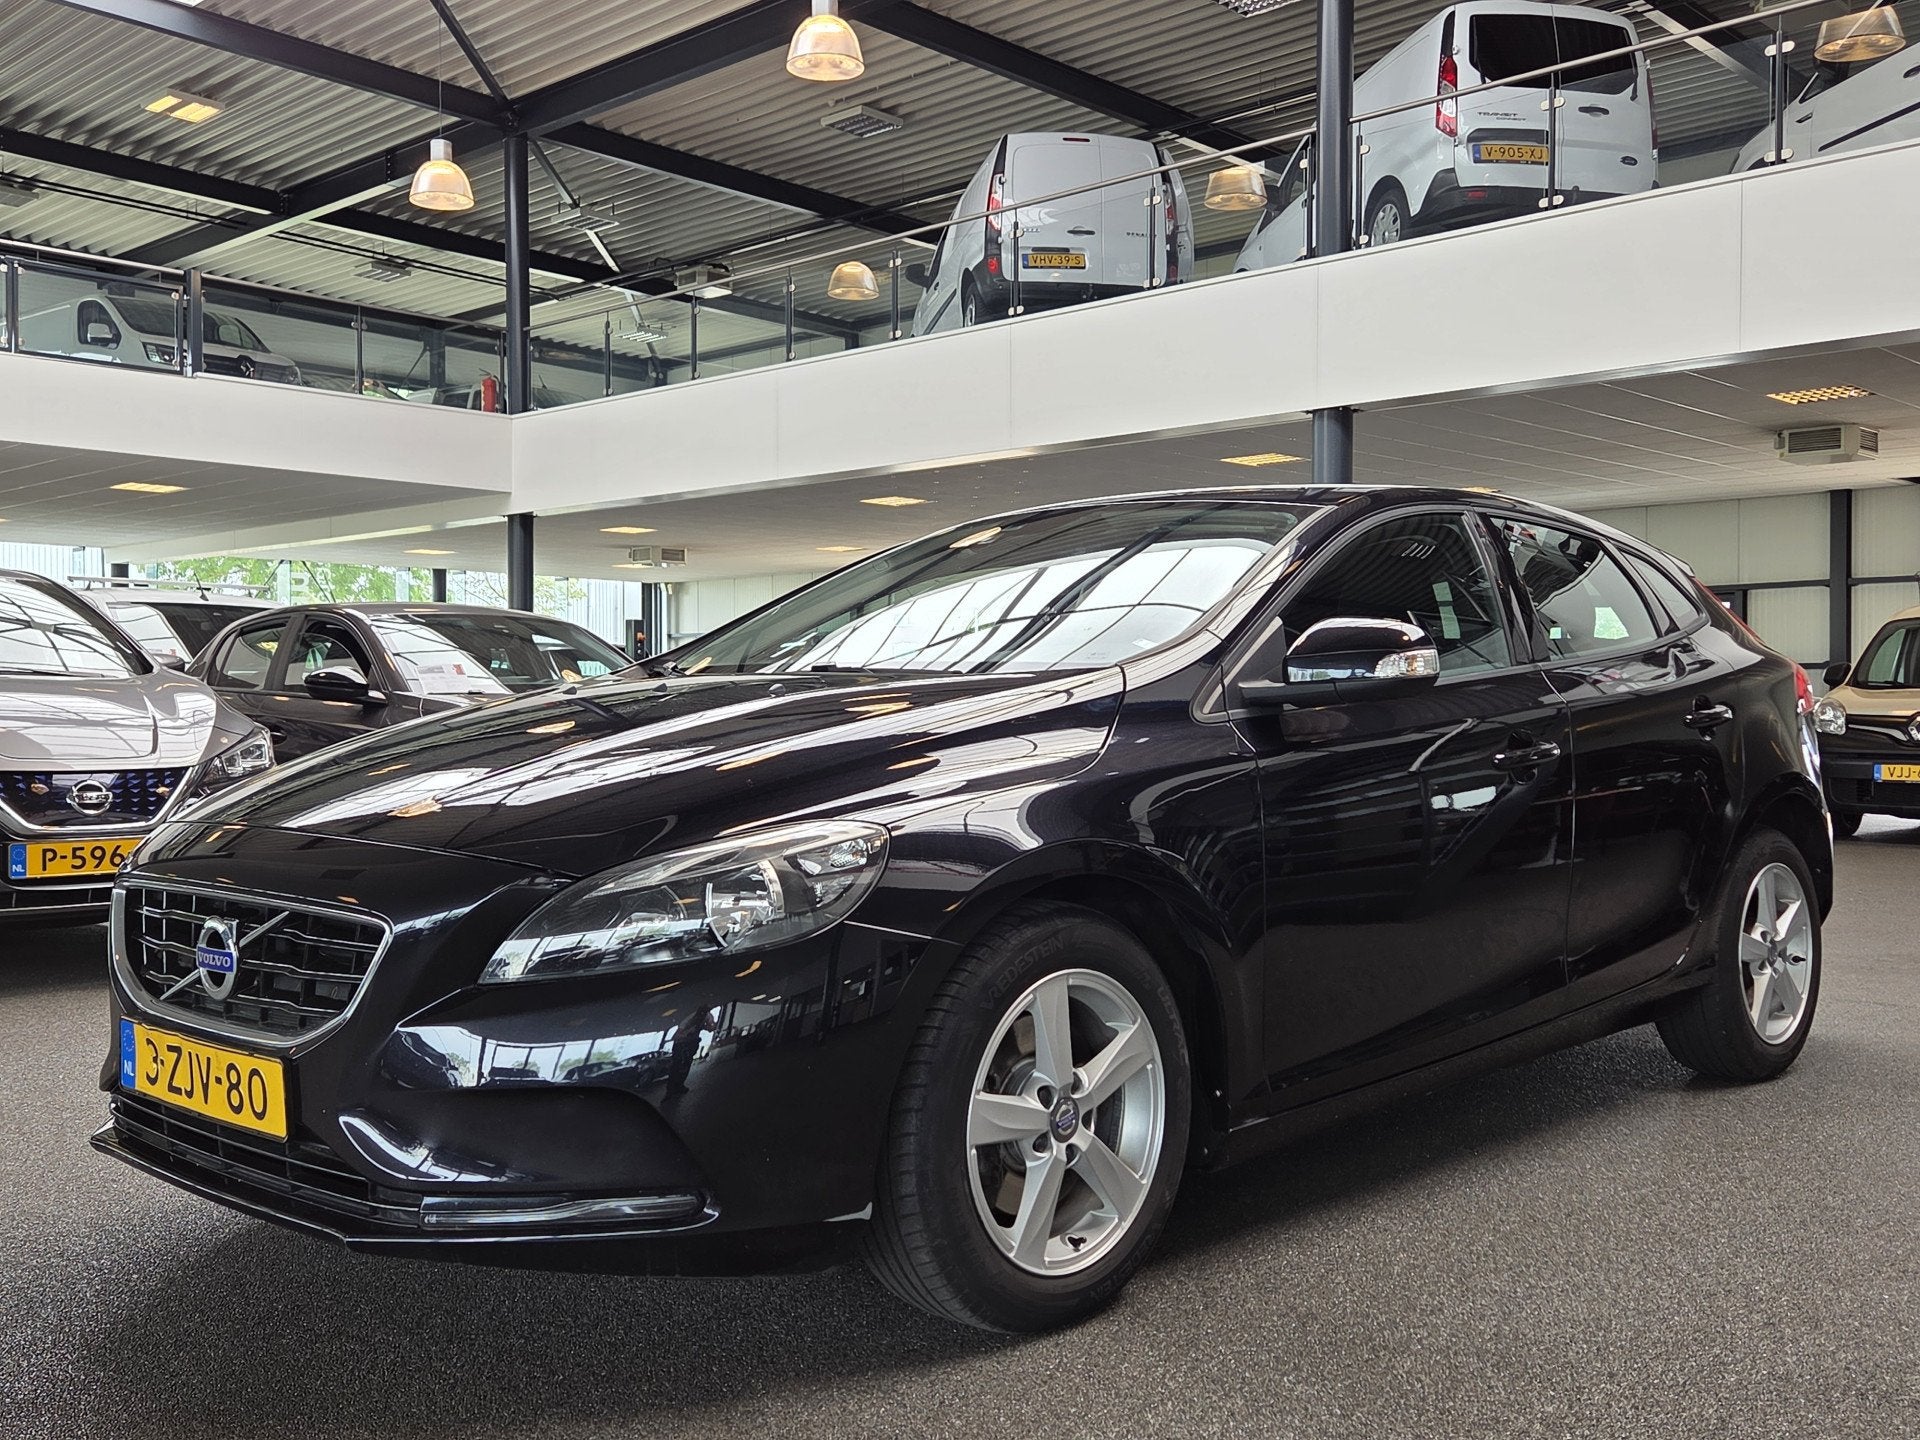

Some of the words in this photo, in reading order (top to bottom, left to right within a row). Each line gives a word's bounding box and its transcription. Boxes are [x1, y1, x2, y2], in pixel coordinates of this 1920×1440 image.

[1485, 146, 1543, 160] V-905-XJ
[1031, 255, 1081, 265] VHV-39-S
[12, 864, 25, 873] NL
[198, 950, 231, 968] VOLVO
[979, 935, 1065, 1010] VREDESTEIN
[123, 1059, 135, 1077] NL
[145, 1037, 268, 1121] 3-ZJV-80
